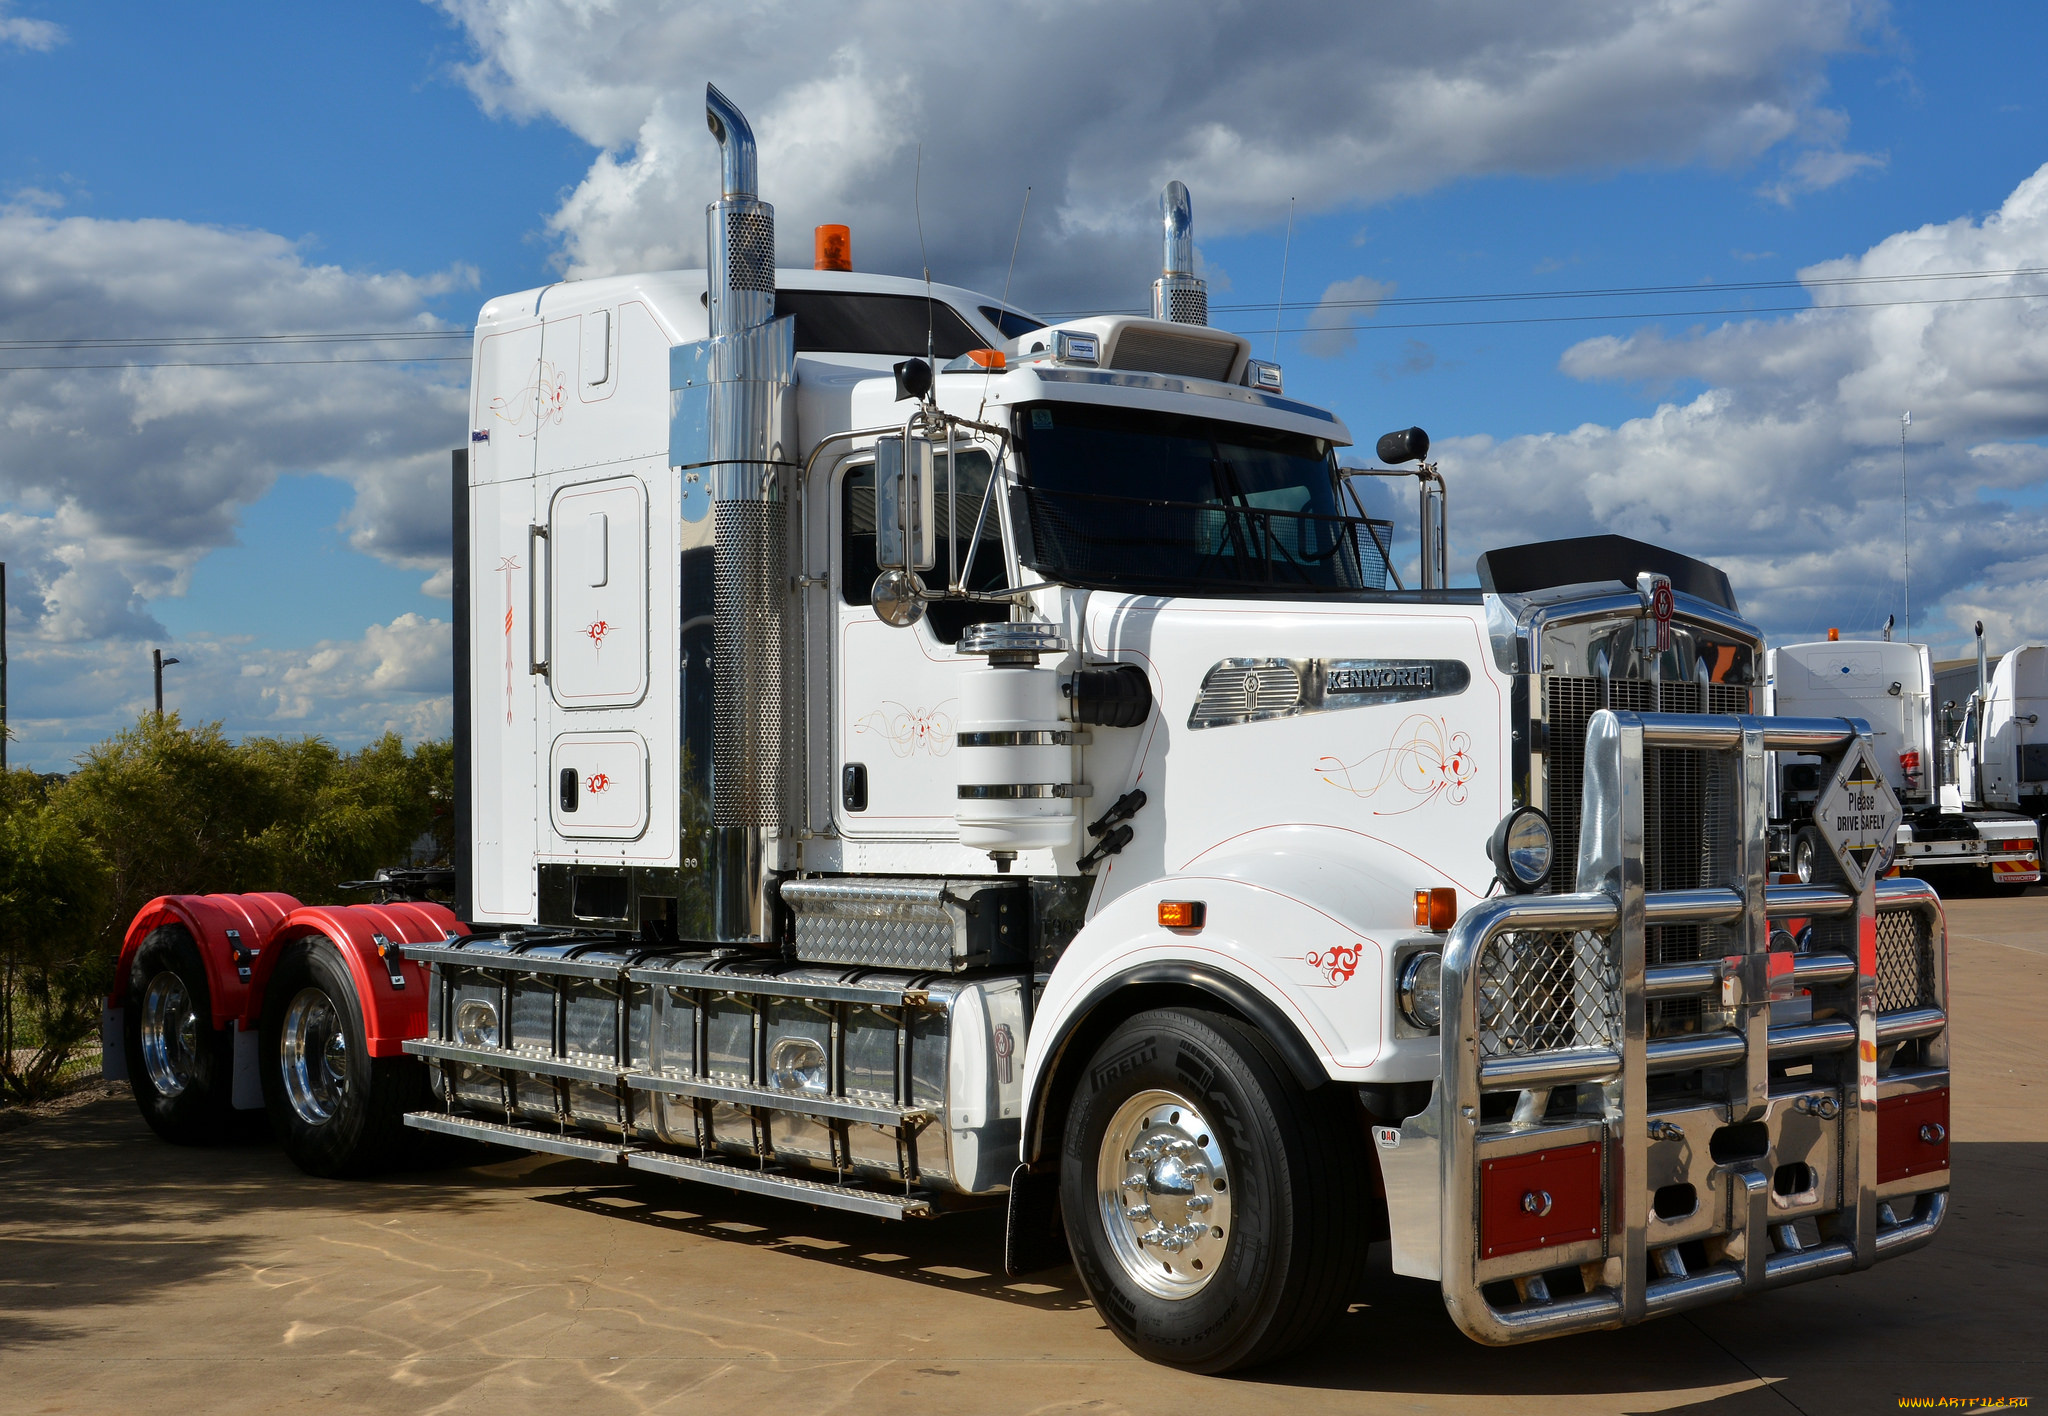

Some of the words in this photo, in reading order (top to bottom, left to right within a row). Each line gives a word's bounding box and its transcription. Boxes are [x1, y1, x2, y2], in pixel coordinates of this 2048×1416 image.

[1327, 666, 1433, 689] KENWORTH
[1848, 792, 1875, 811] Please
[1837, 815, 1859, 831] DRIVE
[1861, 814, 1886, 830] SAFELY
[1090, 1036, 1159, 1094] PIRELLI
